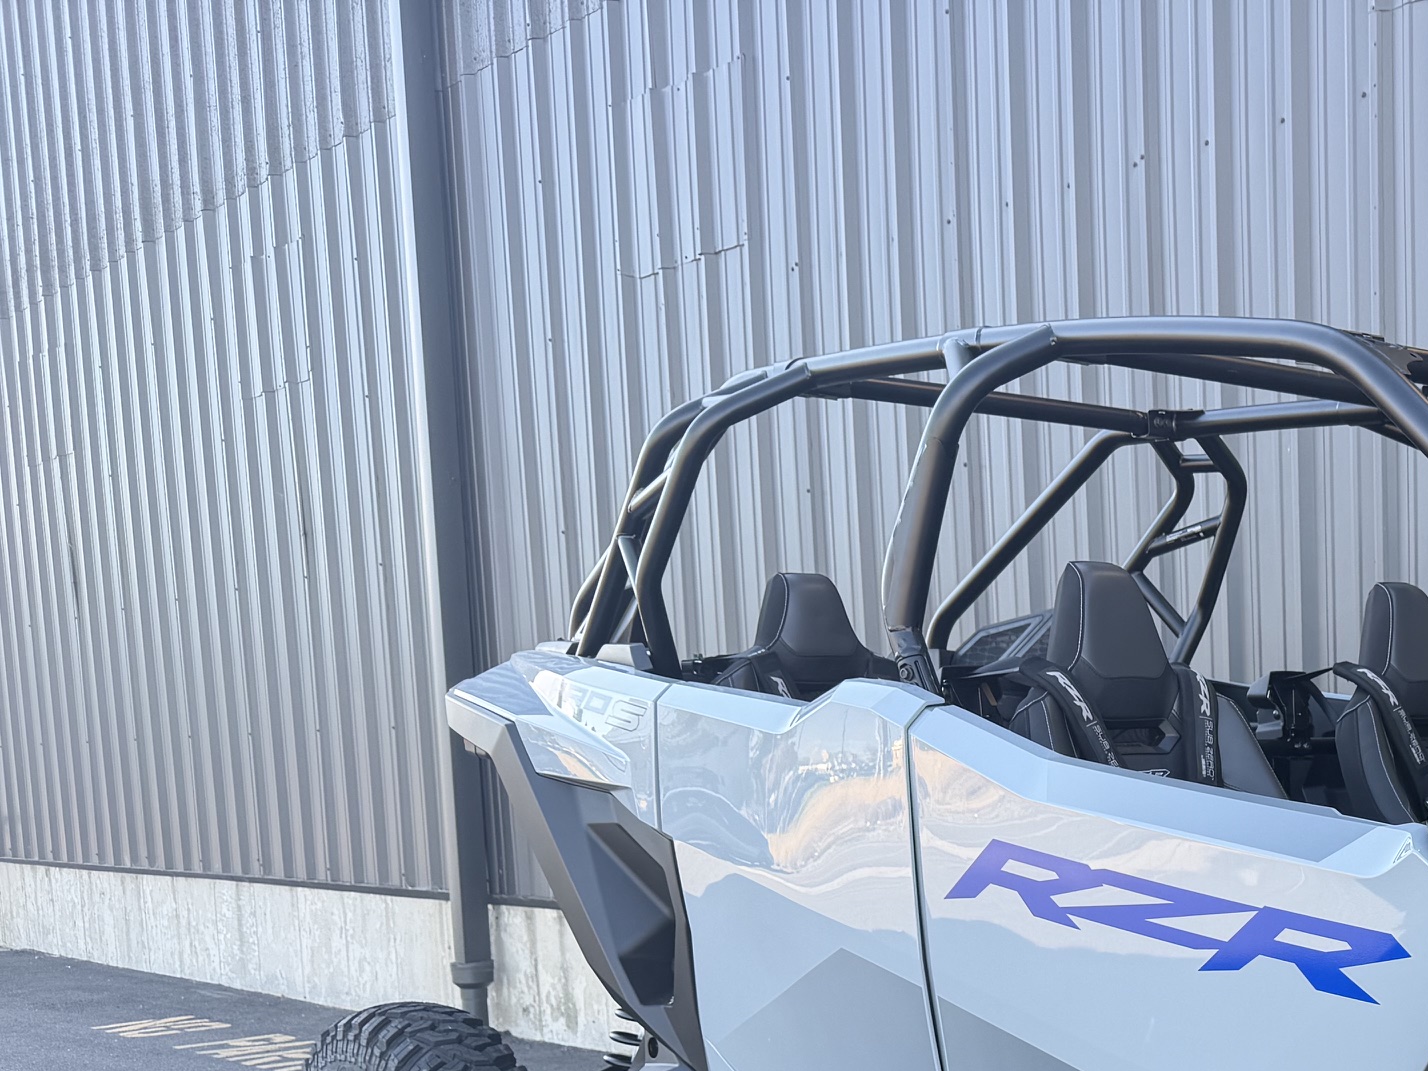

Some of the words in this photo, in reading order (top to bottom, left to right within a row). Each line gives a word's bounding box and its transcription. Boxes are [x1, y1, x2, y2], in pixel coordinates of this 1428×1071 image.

[1046, 671, 1094, 721] RZR
[1357, 668, 1398, 706] RZR
[944, 839, 1412, 1005] RZR
[91, 1015, 231, 1038] NO
